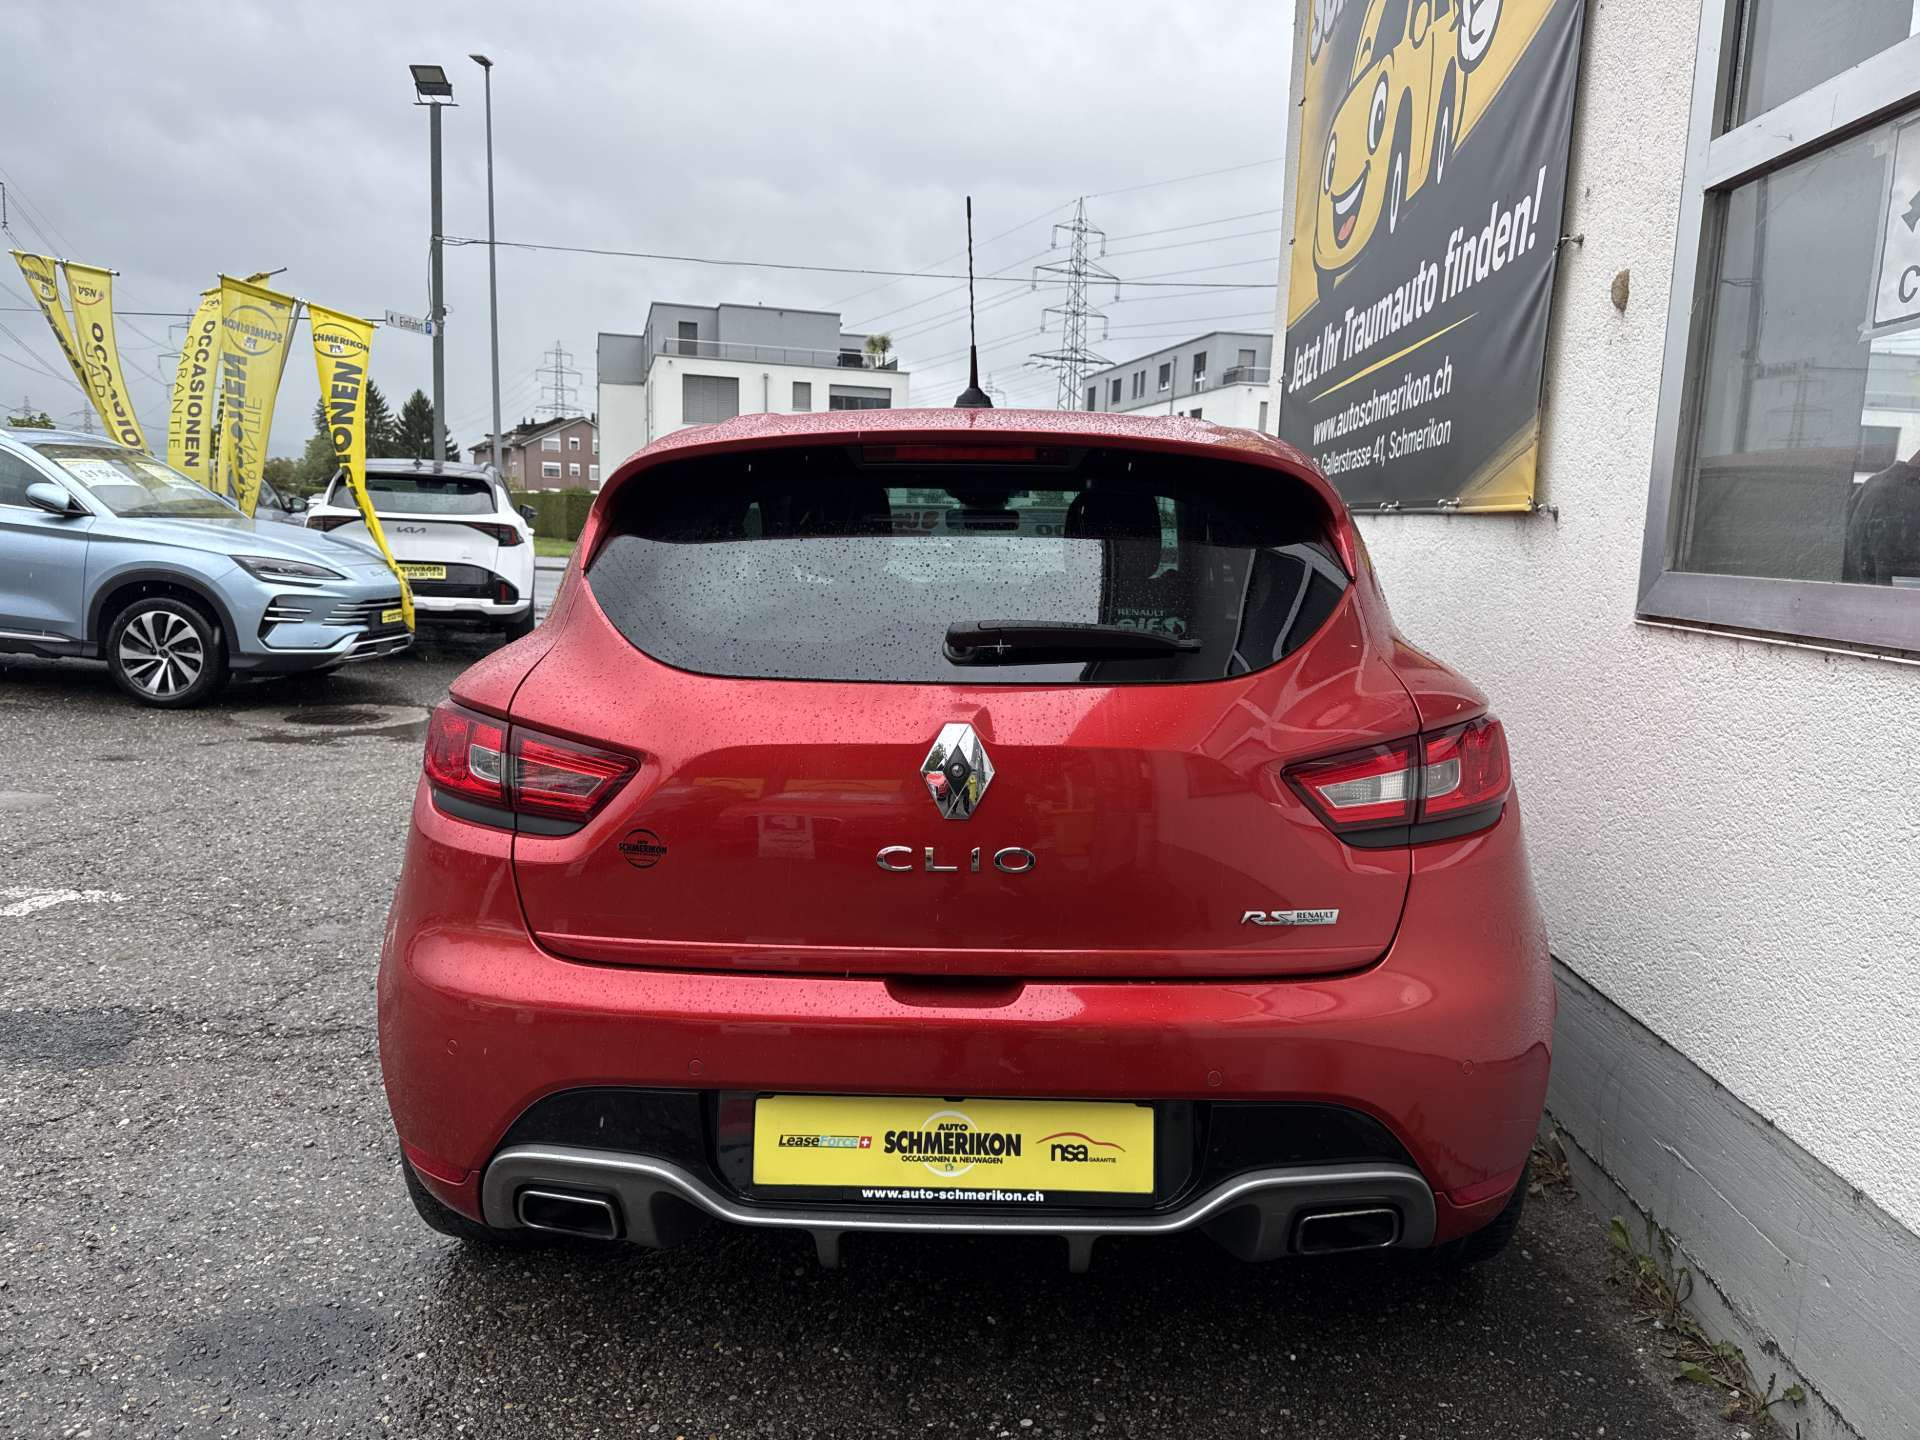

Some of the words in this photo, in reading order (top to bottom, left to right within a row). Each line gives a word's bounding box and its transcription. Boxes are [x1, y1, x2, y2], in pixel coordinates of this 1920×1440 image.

[1288, 337, 1321, 394] Jetzt
[1320, 321, 1342, 375] Ihr
[1342, 260, 1438, 361] Traumauto
[1441, 165, 1547, 303] finden!
[169, 335, 195, 449] GARANTIE
[184, 320, 216, 468] OCCASIONEN
[1313, 356, 1453, 446] www.autoschmerikon.ch
[1372, 435, 1386, 467] 41,
[1388, 418, 1452, 459] Schmerikon
[1118, 607, 1164, 616] RENAULT
[876, 845, 1036, 874] CLIO
[1296, 911, 1334, 919] RENAULT
[937, 1123, 968, 1132] AUTO
[779, 1134, 859, 1147] LeaseForce
[884, 1130, 1022, 1157] SCHMERIKON
[901, 1155, 950, 1163] OCCASIONEN
[959, 1156, 1003, 1164] NEUWAGEN
[1050, 1144, 1088, 1162] nsa
[861, 1187, 1045, 1203] www.auto-schmerikon.ch
